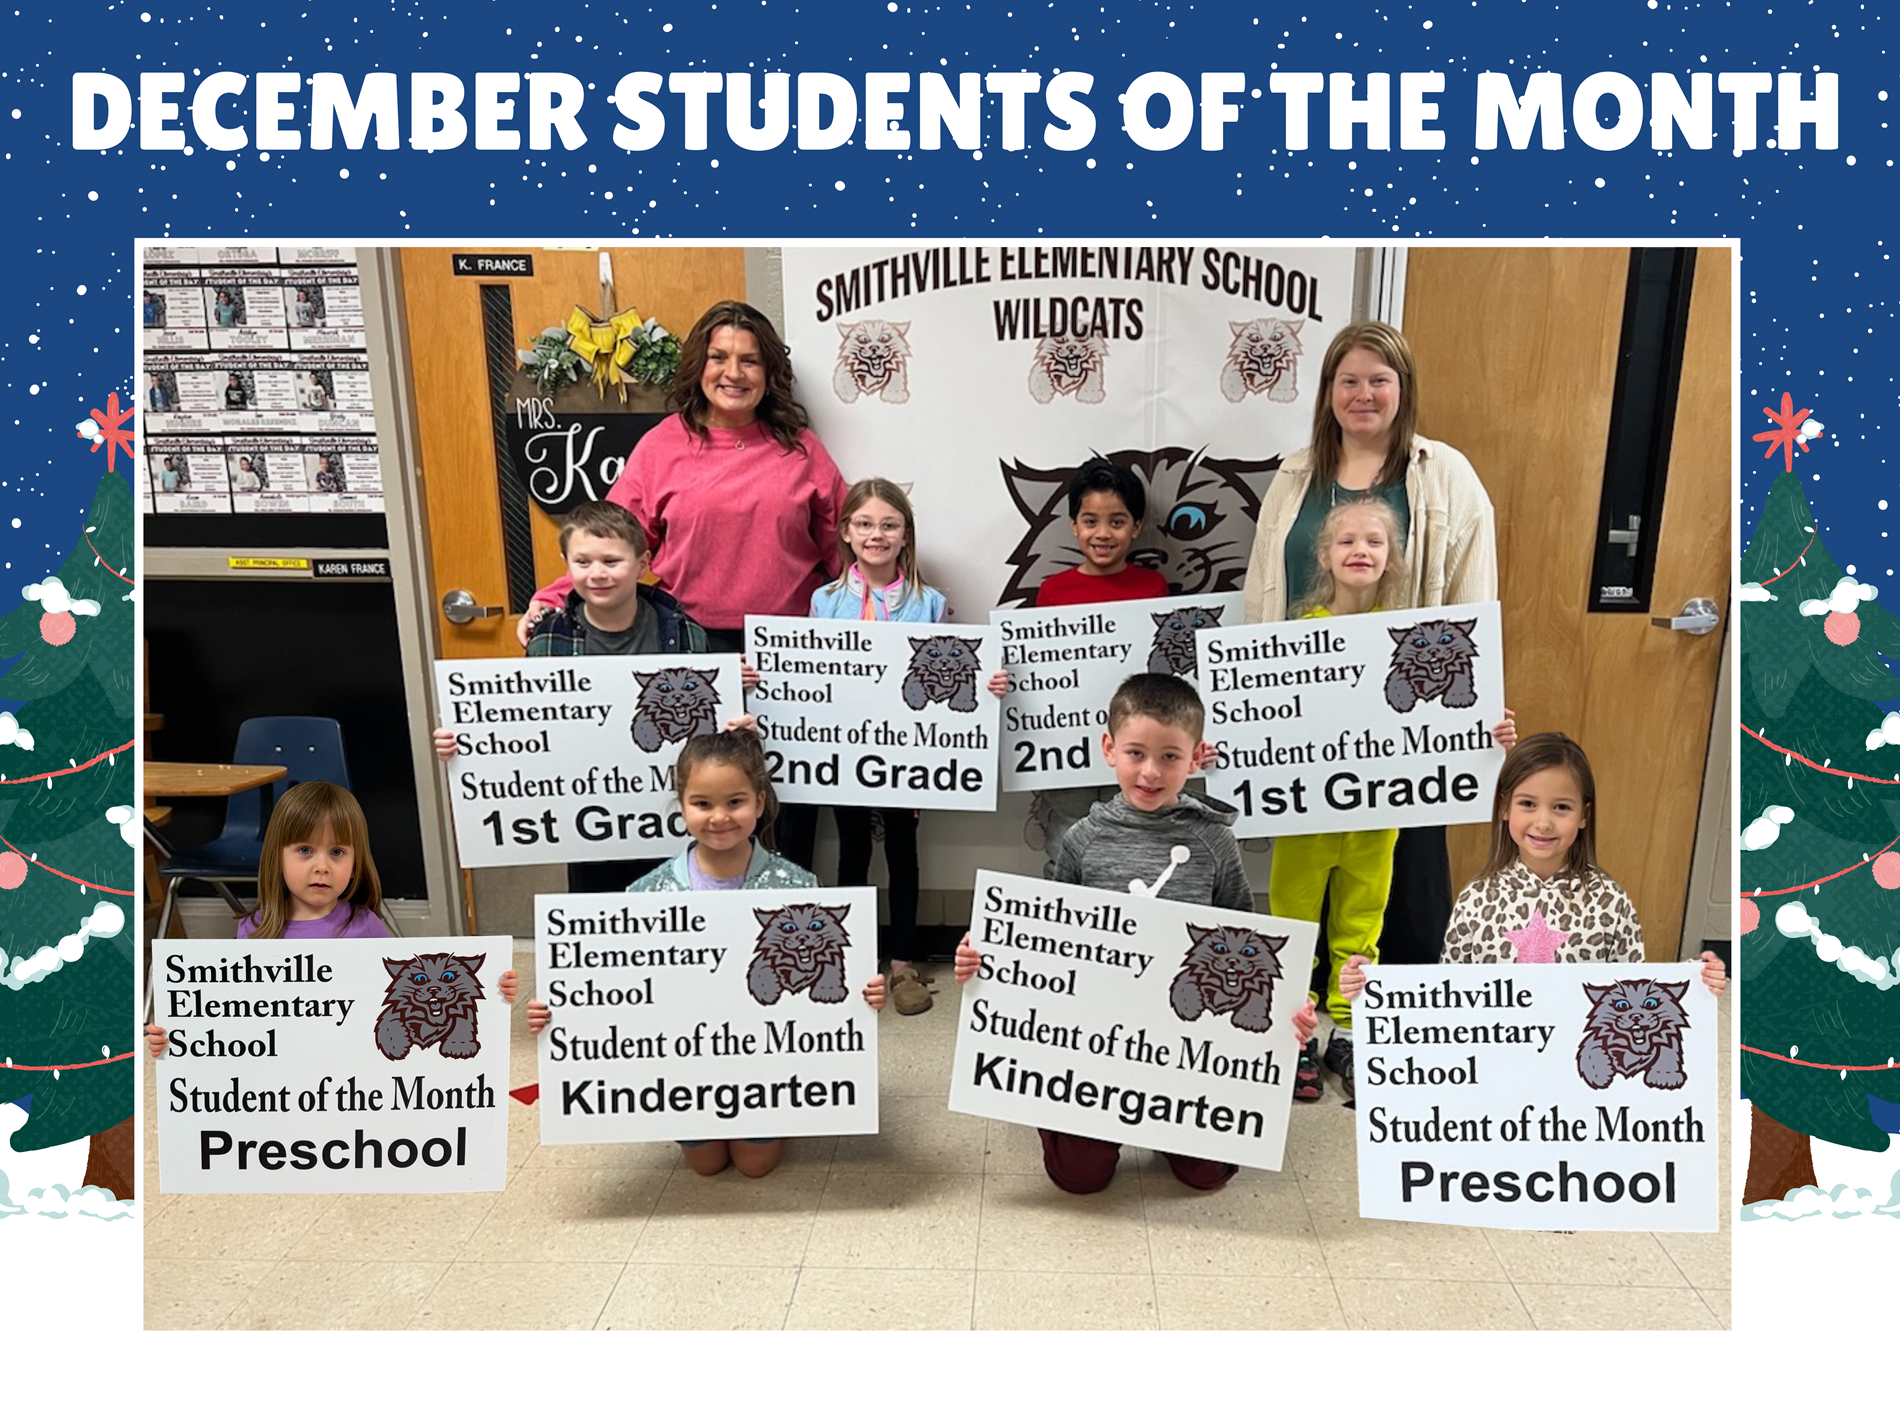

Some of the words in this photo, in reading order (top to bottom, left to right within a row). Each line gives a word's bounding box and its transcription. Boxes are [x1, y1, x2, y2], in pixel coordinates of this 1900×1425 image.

[458, 259, 472, 271] K.
[477, 259, 527, 271] FRANCE
[815, 247, 992, 323] SMITHVILLE
[1000, 247, 1194, 286] ELEMENTARY
[1201, 250, 1323, 322] SCHOOL
[993, 296, 1144, 341] WILDCATS
[516, 398, 562, 429] MRS.
[318, 564, 348, 575] KAREN
[351, 564, 385, 574] FRANCE
[754, 626, 872, 652] Smithville
[1000, 613, 1116, 641] Smithville
[1002, 644, 1129, 666] Elementary
[1207, 629, 1345, 664] Smithville
[448, 669, 591, 695] Smithville
[756, 651, 888, 686] Elementary
[1003, 668, 1079, 692] School
[1210, 665, 1365, 692] Elementary
[755, 680, 832, 703] School
[453, 700, 612, 727] Elementary
[1005, 704, 1091, 732] Student
[1096, 709, 1108, 726] o
[1212, 694, 1302, 725] School
[456, 730, 550, 756] School
[756, 715, 842, 744] Student
[847, 719, 872, 744] of
[874, 720, 908, 747] the
[913, 722, 988, 750] Month
[1215, 737, 1315, 770] Student
[1322, 730, 1351, 762] of
[1353, 729, 1395, 759] the
[1401, 719, 1494, 756] Month
[764, 751, 839, 786] 2nd
[855, 754, 983, 792] Grade
[1014, 736, 1091, 773] 2nd
[461, 769, 565, 801] Student
[571, 766, 599, 795] of
[602, 765, 643, 794] the
[1231, 777, 1308, 818] 1st
[1324, 765, 1479, 811] Grade
[483, 809, 560, 846] 1st
[548, 905, 706, 936] Smithville
[984, 886, 1137, 936] Smithville
[549, 941, 727, 974] Elementary
[978, 917, 1154, 980] Elementary
[166, 953, 333, 984] Smithville
[976, 953, 1076, 996] School
[166, 989, 356, 1027] Elementary
[549, 977, 654, 1007] School
[1364, 978, 1533, 1010] Smithville
[168, 1028, 278, 1058] School
[550, 1025, 667, 1062] Student
[674, 1022, 707, 1057] of
[710, 1021, 756, 1056] the
[763, 1017, 864, 1055] Month
[970, 998, 1083, 1051] Student
[1088, 1024, 1124, 1057] of
[1125, 1028, 1170, 1067] the
[1176, 1036, 1280, 1086] Month
[1365, 1015, 1555, 1053] Elementary
[1367, 1055, 1478, 1086] School
[169, 1076, 291, 1113] Student
[298, 1076, 333, 1113] of
[335, 1075, 384, 1112] the
[390, 1073, 496, 1111] Month
[562, 1074, 855, 1119] Kindergarten
[973, 1052, 1264, 1138] Kindergarten
[1369, 1105, 1493, 1143] Student
[1500, 1104, 1535, 1142] of
[1538, 1105, 1587, 1142] the
[1595, 1105, 1705, 1143] Month
[200, 1126, 467, 1171] Preschool
[1401, 1160, 1675, 1204] Preschool
